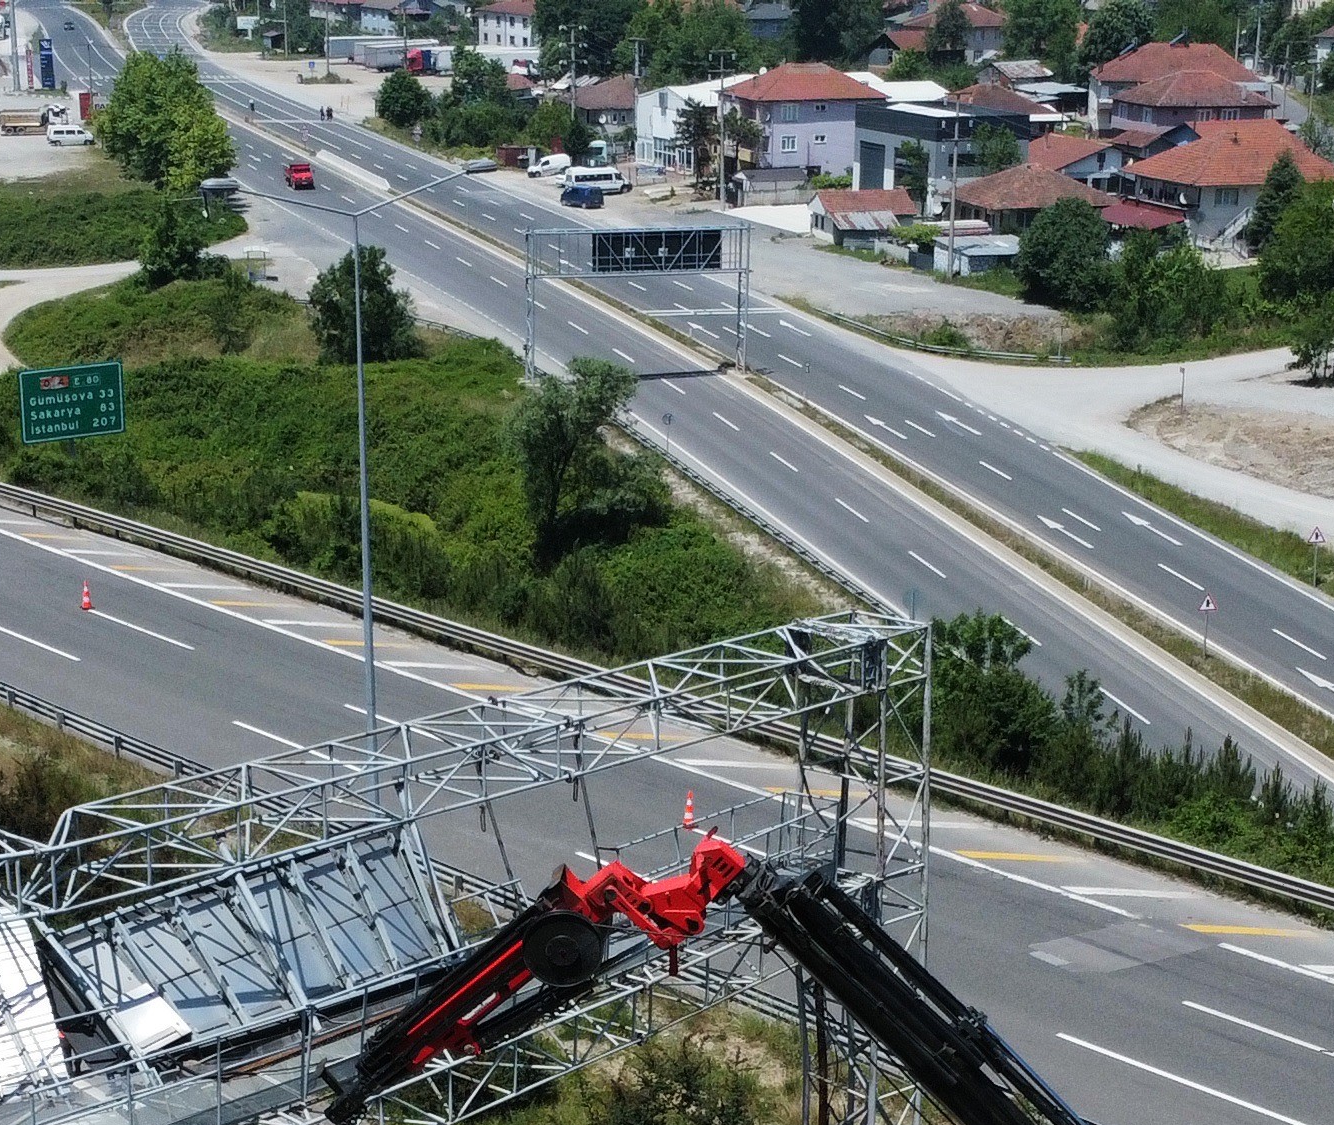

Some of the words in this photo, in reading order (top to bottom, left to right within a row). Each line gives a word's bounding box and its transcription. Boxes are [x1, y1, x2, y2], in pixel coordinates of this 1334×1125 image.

[29, 391, 93, 407] Gümüşova
[99, 388, 114, 399] 33
[30, 407, 81, 421] Sakarya
[30, 420, 79, 435] İstanbul
[92, 415, 116, 427] 207
